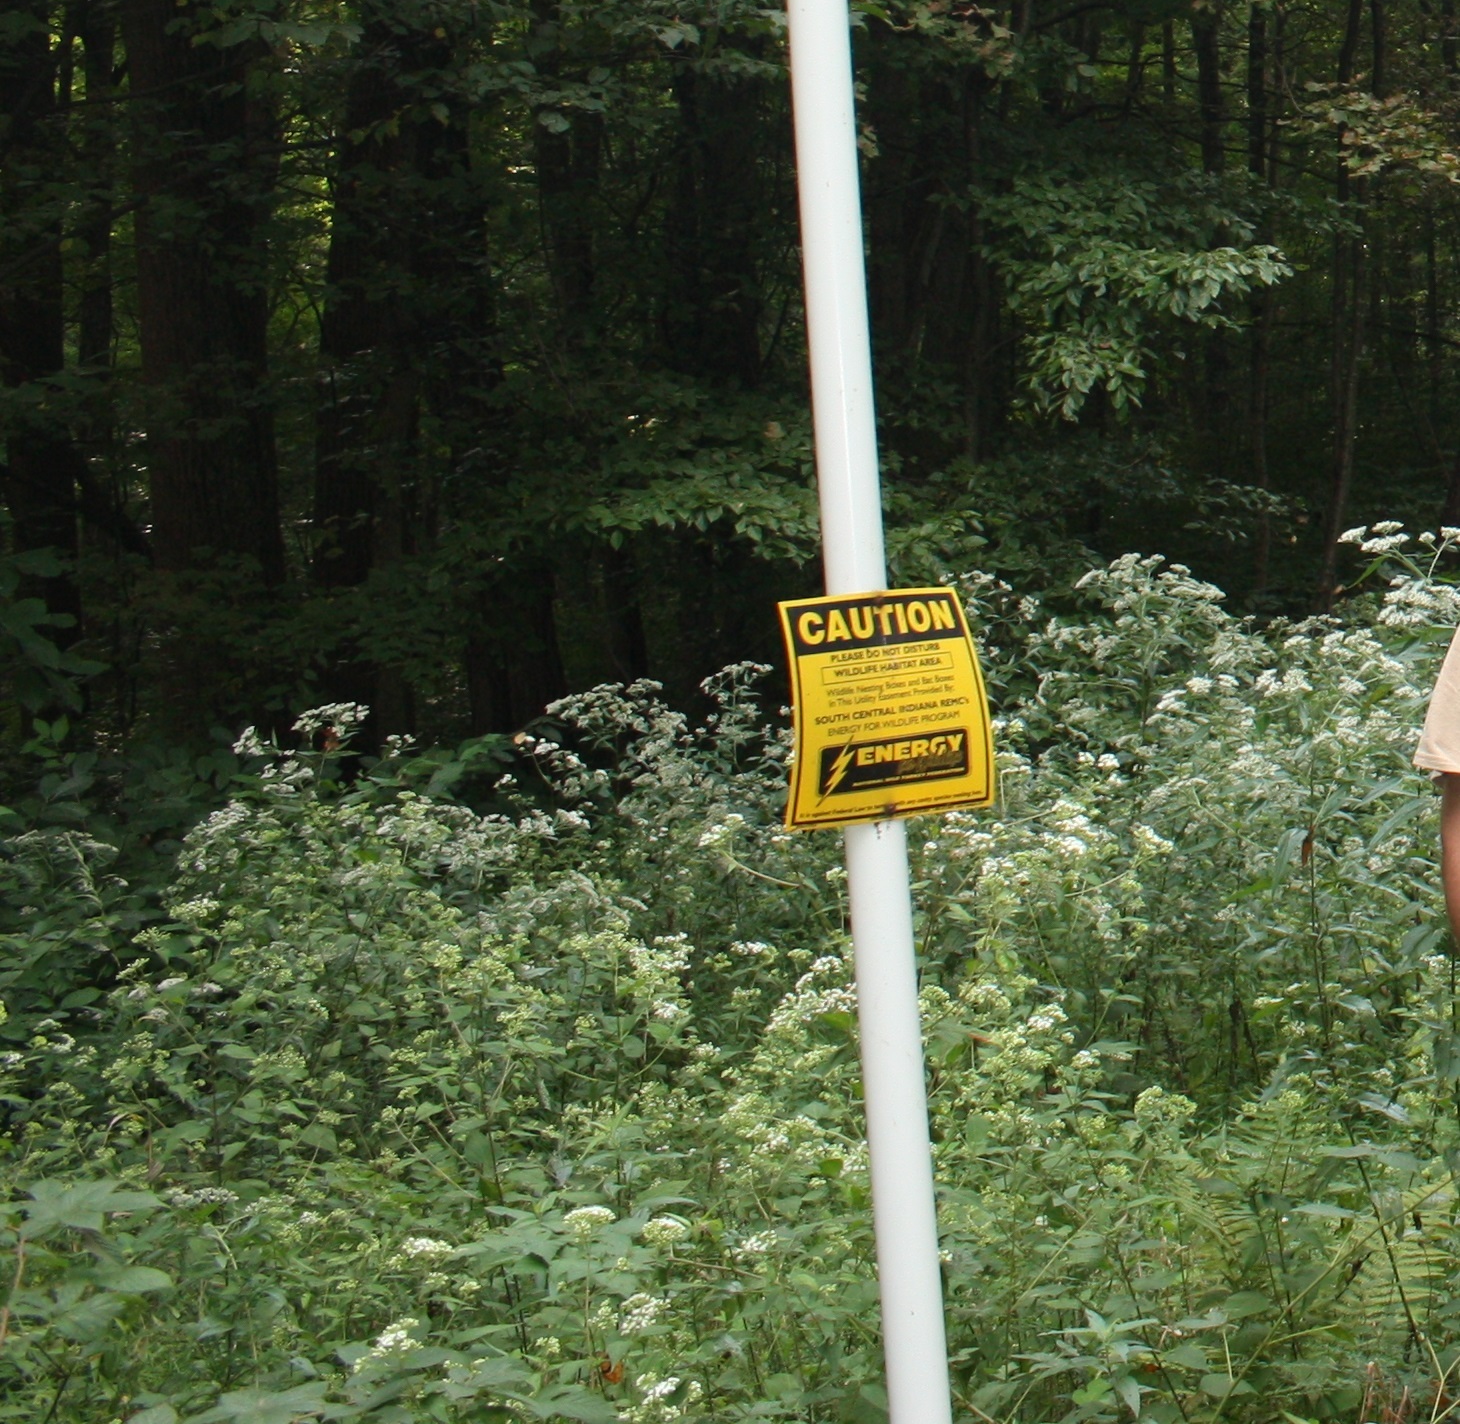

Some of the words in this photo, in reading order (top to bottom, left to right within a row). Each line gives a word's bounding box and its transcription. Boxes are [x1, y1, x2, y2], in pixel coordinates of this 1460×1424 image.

[798, 599, 956, 645] CAUTION
[830, 651, 864, 663] PLEASE
[867, 650, 880, 659] DO
[882, 647, 901, 657] NOT
[903, 643, 940, 654] DISTURB
[834, 665, 878, 677] WILDLIFE
[880, 660, 917, 672] HABITAT
[919, 657, 942, 667] AREA
[826, 687, 854, 697] Wildlife
[908, 678, 920, 687] and
[837, 697, 852, 707] This
[913, 686, 943, 695] Provided
[815, 713, 850, 725] SOUTH
[852, 707, 895, 720] CENTRAL
[898, 701, 938, 713] INDIANA
[827, 724, 862, 737] ENERGY
[864, 722, 881, 731] FOR
[883, 716, 919, 728] WILDLIFE
[921, 710, 960, 723] PROGRAM
[856, 733, 964, 767] ENERGY
